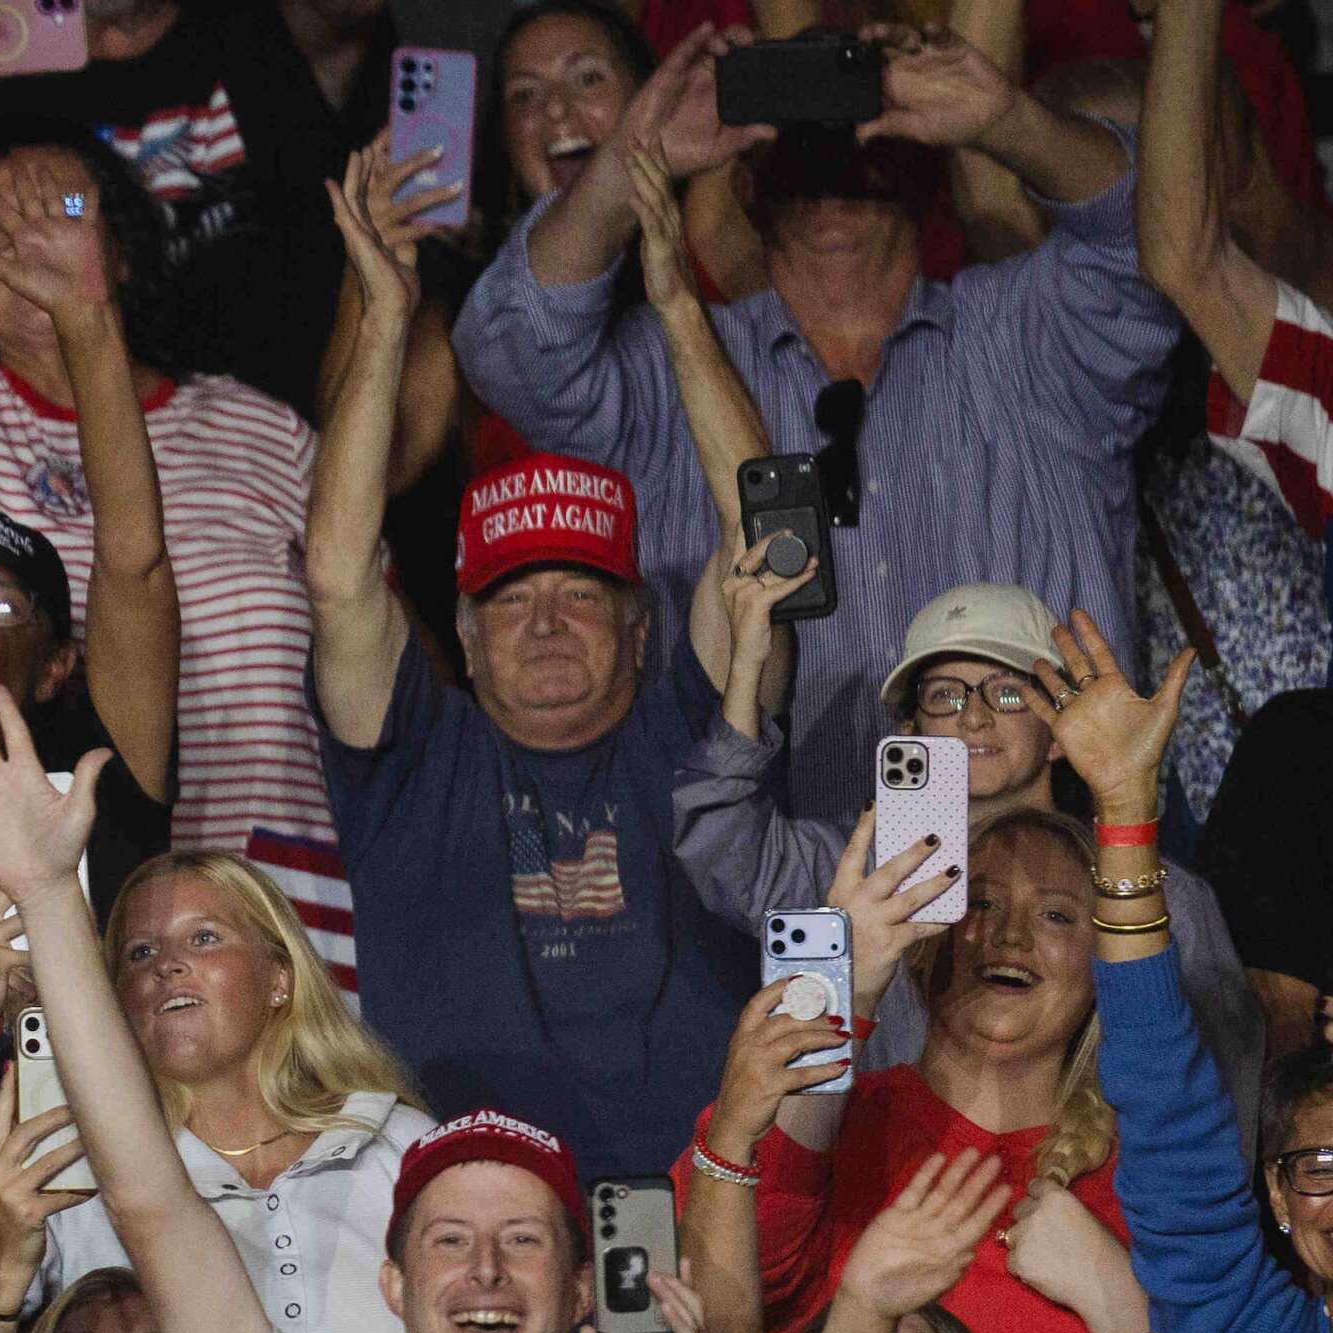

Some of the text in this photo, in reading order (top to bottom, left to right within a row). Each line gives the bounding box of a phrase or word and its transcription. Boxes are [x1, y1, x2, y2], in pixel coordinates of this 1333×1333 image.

[471, 469, 624, 516] MAKE AMERICA
[483, 502, 615, 544] GREAT AGAIN
[418, 1116, 472, 1149] MAKE
[475, 1110, 561, 1153] AMERICA
